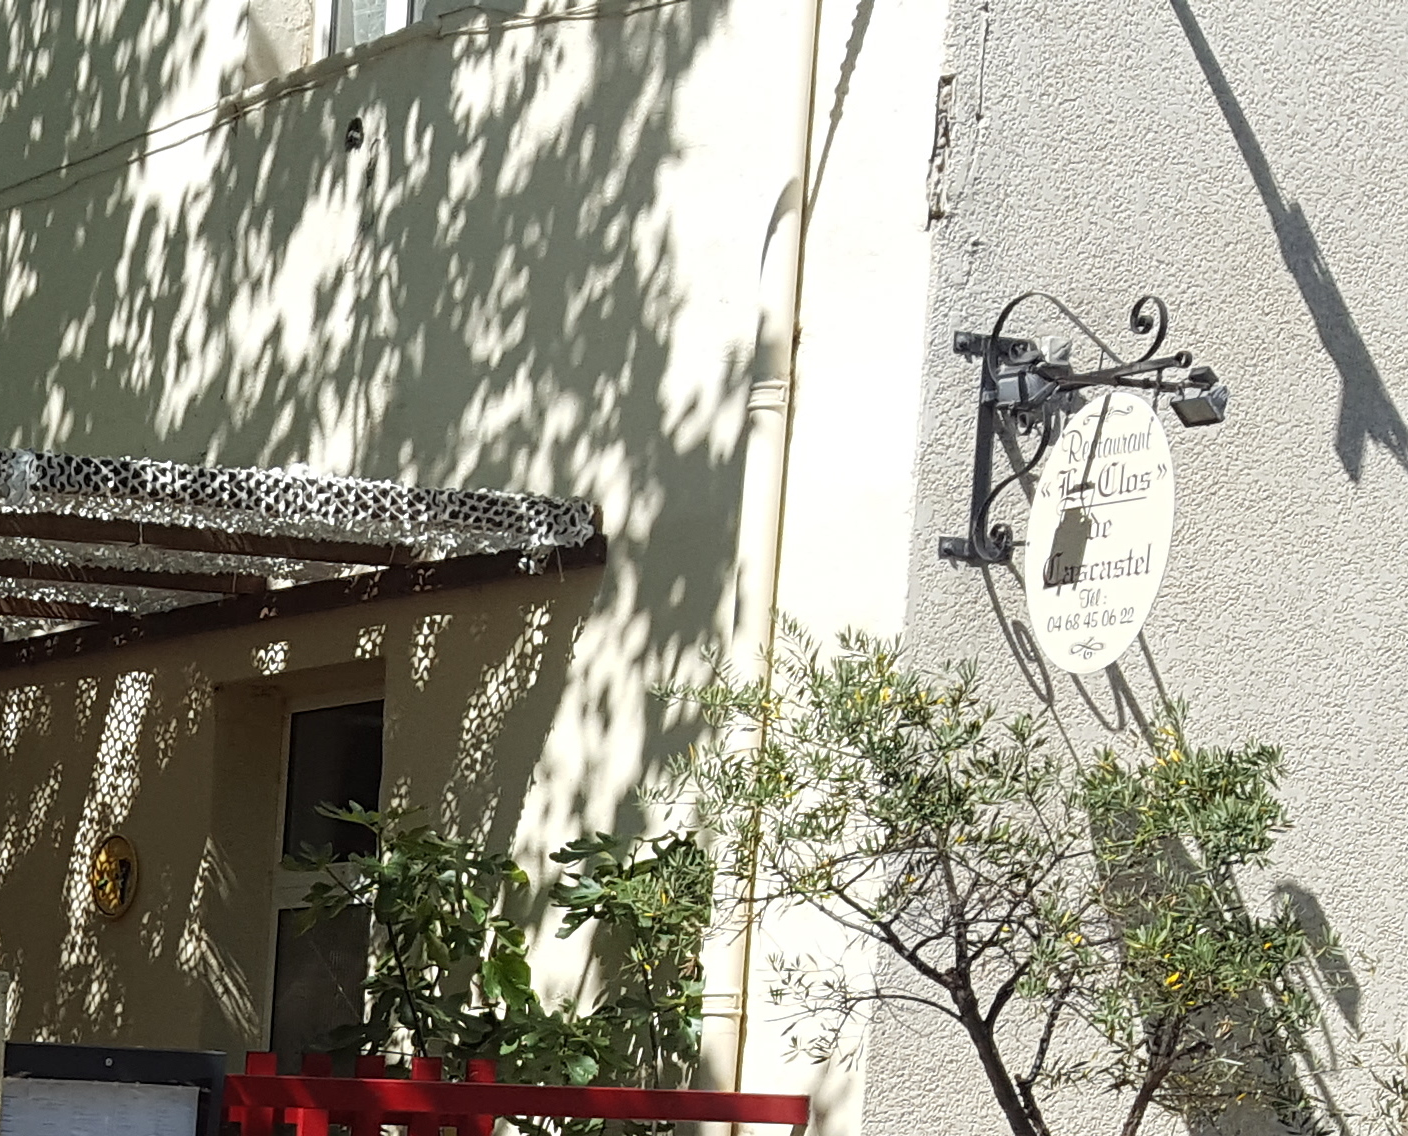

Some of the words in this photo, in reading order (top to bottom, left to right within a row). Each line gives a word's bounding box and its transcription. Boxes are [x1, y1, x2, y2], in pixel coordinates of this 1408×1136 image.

[1062, 416, 1153, 464] Restaurant
[1097, 461, 1153, 498] Clos
[1086, 512, 1113, 541] de
[1042, 543, 1152, 590] Cascastel
[1046, 615, 1062, 633] 04
[1065, 613, 1081, 631] 68
[1083, 611, 1099, 629] 45
[1101, 609, 1117, 627] 06
[1119, 606, 1135, 625] 22
